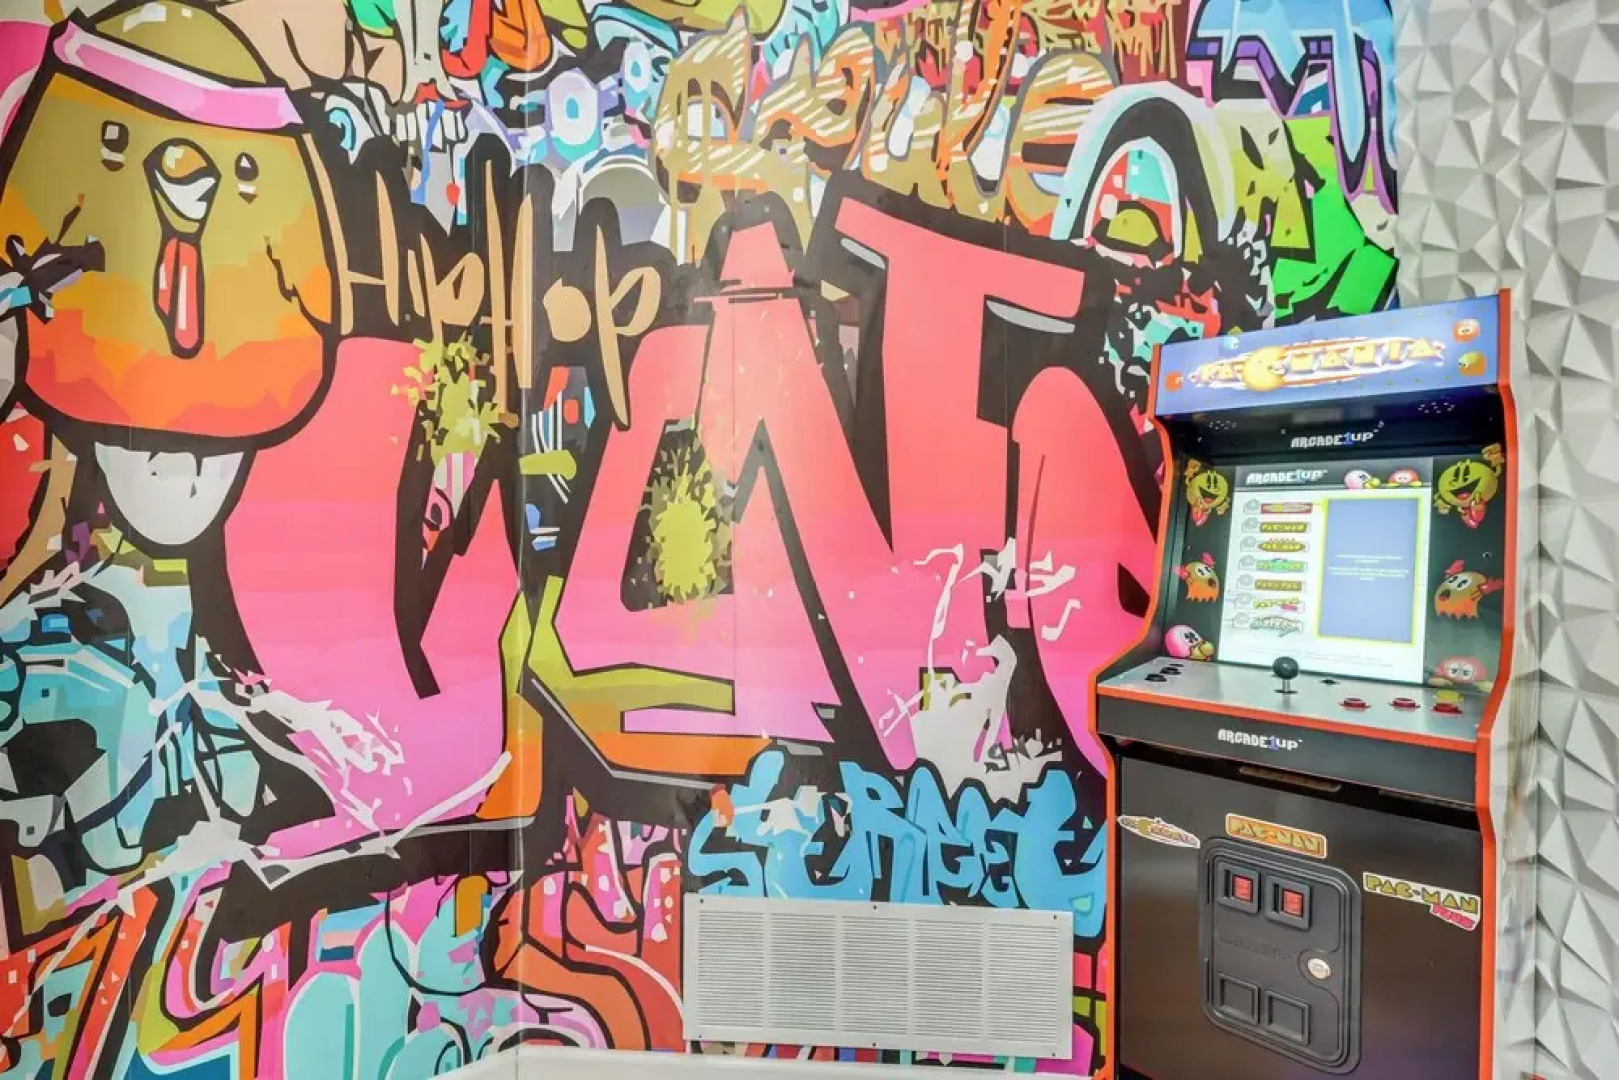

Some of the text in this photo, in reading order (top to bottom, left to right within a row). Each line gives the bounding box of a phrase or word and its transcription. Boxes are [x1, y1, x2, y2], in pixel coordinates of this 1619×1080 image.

[1218, 729, 1299, 751] ARCADE1UP
[1229, 819, 1321, 852] PAC-MAN
[1366, 874, 1478, 914] PAC-MAN
